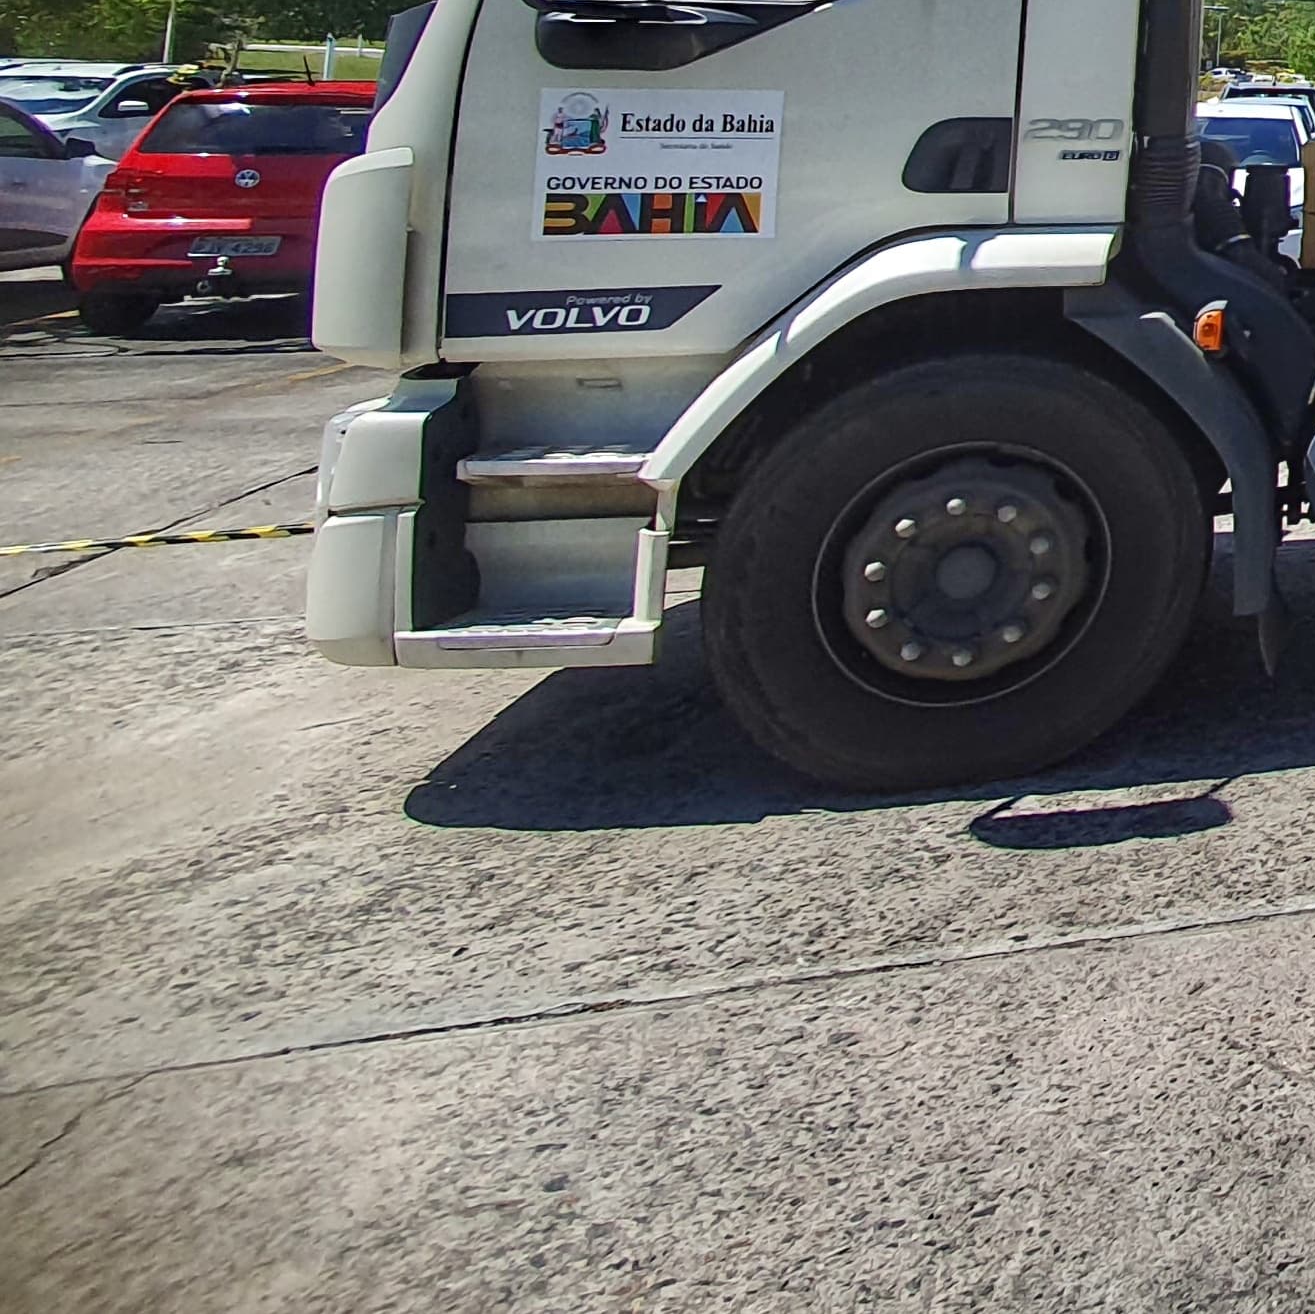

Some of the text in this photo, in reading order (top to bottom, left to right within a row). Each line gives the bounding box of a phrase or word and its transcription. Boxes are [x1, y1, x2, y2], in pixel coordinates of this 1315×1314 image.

[620, 112, 775, 134] Estado da Bahia
[1023, 118, 1124, 141] 290
[546, 176, 763, 191] GOVERNO DO ESTADO
[543, 192, 760, 236] BAHIA
[566, 293, 652, 305] Powered by
[506, 305, 651, 331] VOLVO
